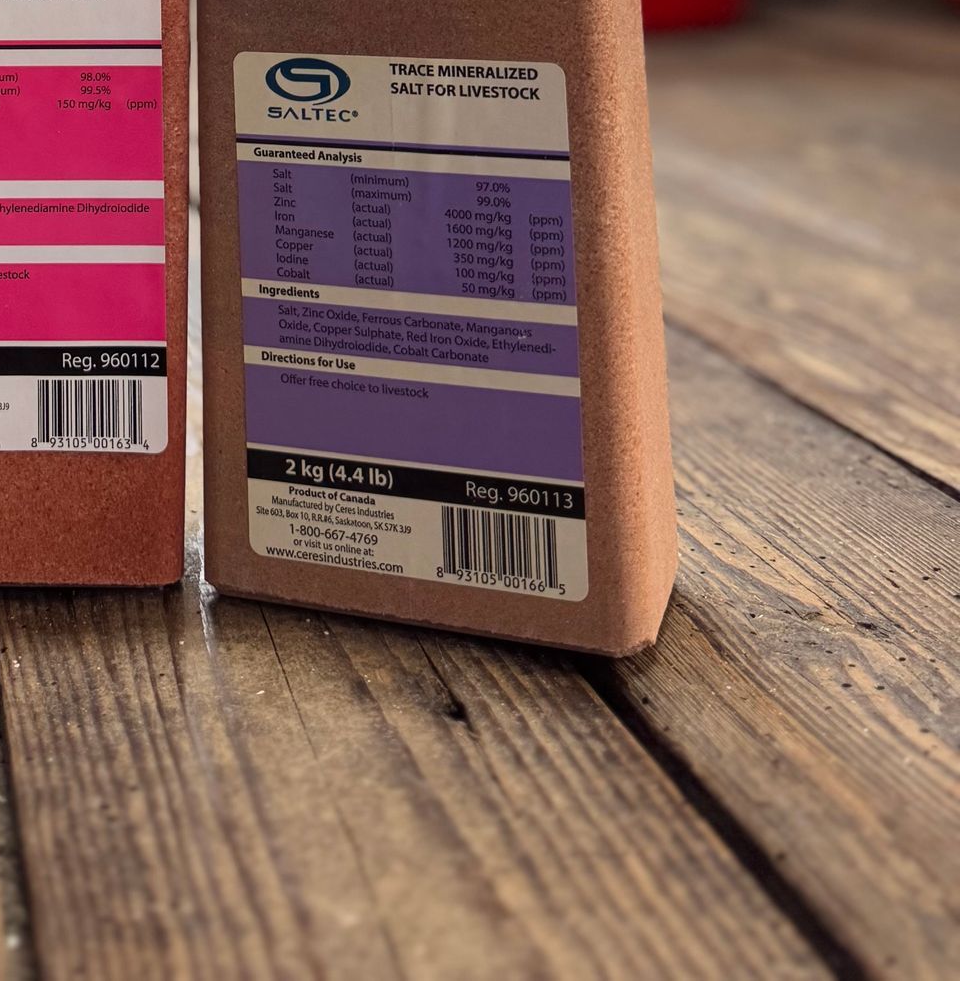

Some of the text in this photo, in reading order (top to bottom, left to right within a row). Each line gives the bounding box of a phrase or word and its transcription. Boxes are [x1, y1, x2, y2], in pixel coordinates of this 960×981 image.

[79, 71, 111, 84] 98.0%
[388, 62, 538, 80] TRACE MINERALIZED
[79, 85, 111, 96] 99.5%
[390, 81, 540, 100] SALT FOR LIVESTOCK
[57, 98, 77, 108] 150
[77, 98, 111, 110] mg/kg
[126, 98, 157, 110] (ppm)
[253, 146, 362, 163] Guaranteed Analysis
[272, 168, 510, 194] Salt (minimum) 97.0%
[273, 182, 511, 208] Salt (maximum) 99.0%
[76, 202, 149, 215] Dihydroiodide
[272, 196, 563, 227] Zinc (actual) 4000 mg/kg (ppm)
[258, 283, 319, 298] Ingredients
[277, 304, 532, 338] Salt, Zinc Oxide, Ferrous Carbonate, Manganous
[278, 318, 556, 354] Oxide, Copper Sulphate, Red Iron Oxide, Ethylenedi-
[279, 334, 489, 363] amine Dihydroiodide, Cobalt Carbonate
[62, 352, 159, 371] Reg. 960112
[261, 350, 355, 370] Directions for Use
[285, 458, 393, 489] 2 kg (4.4 lb)
[288, 485, 375, 505] Product of Canada
[465, 480, 573, 509] Reg. 960113
[289, 523, 378, 545] 1-800-667-4769
[265, 546, 403, 573] www.ceresindustries.com
